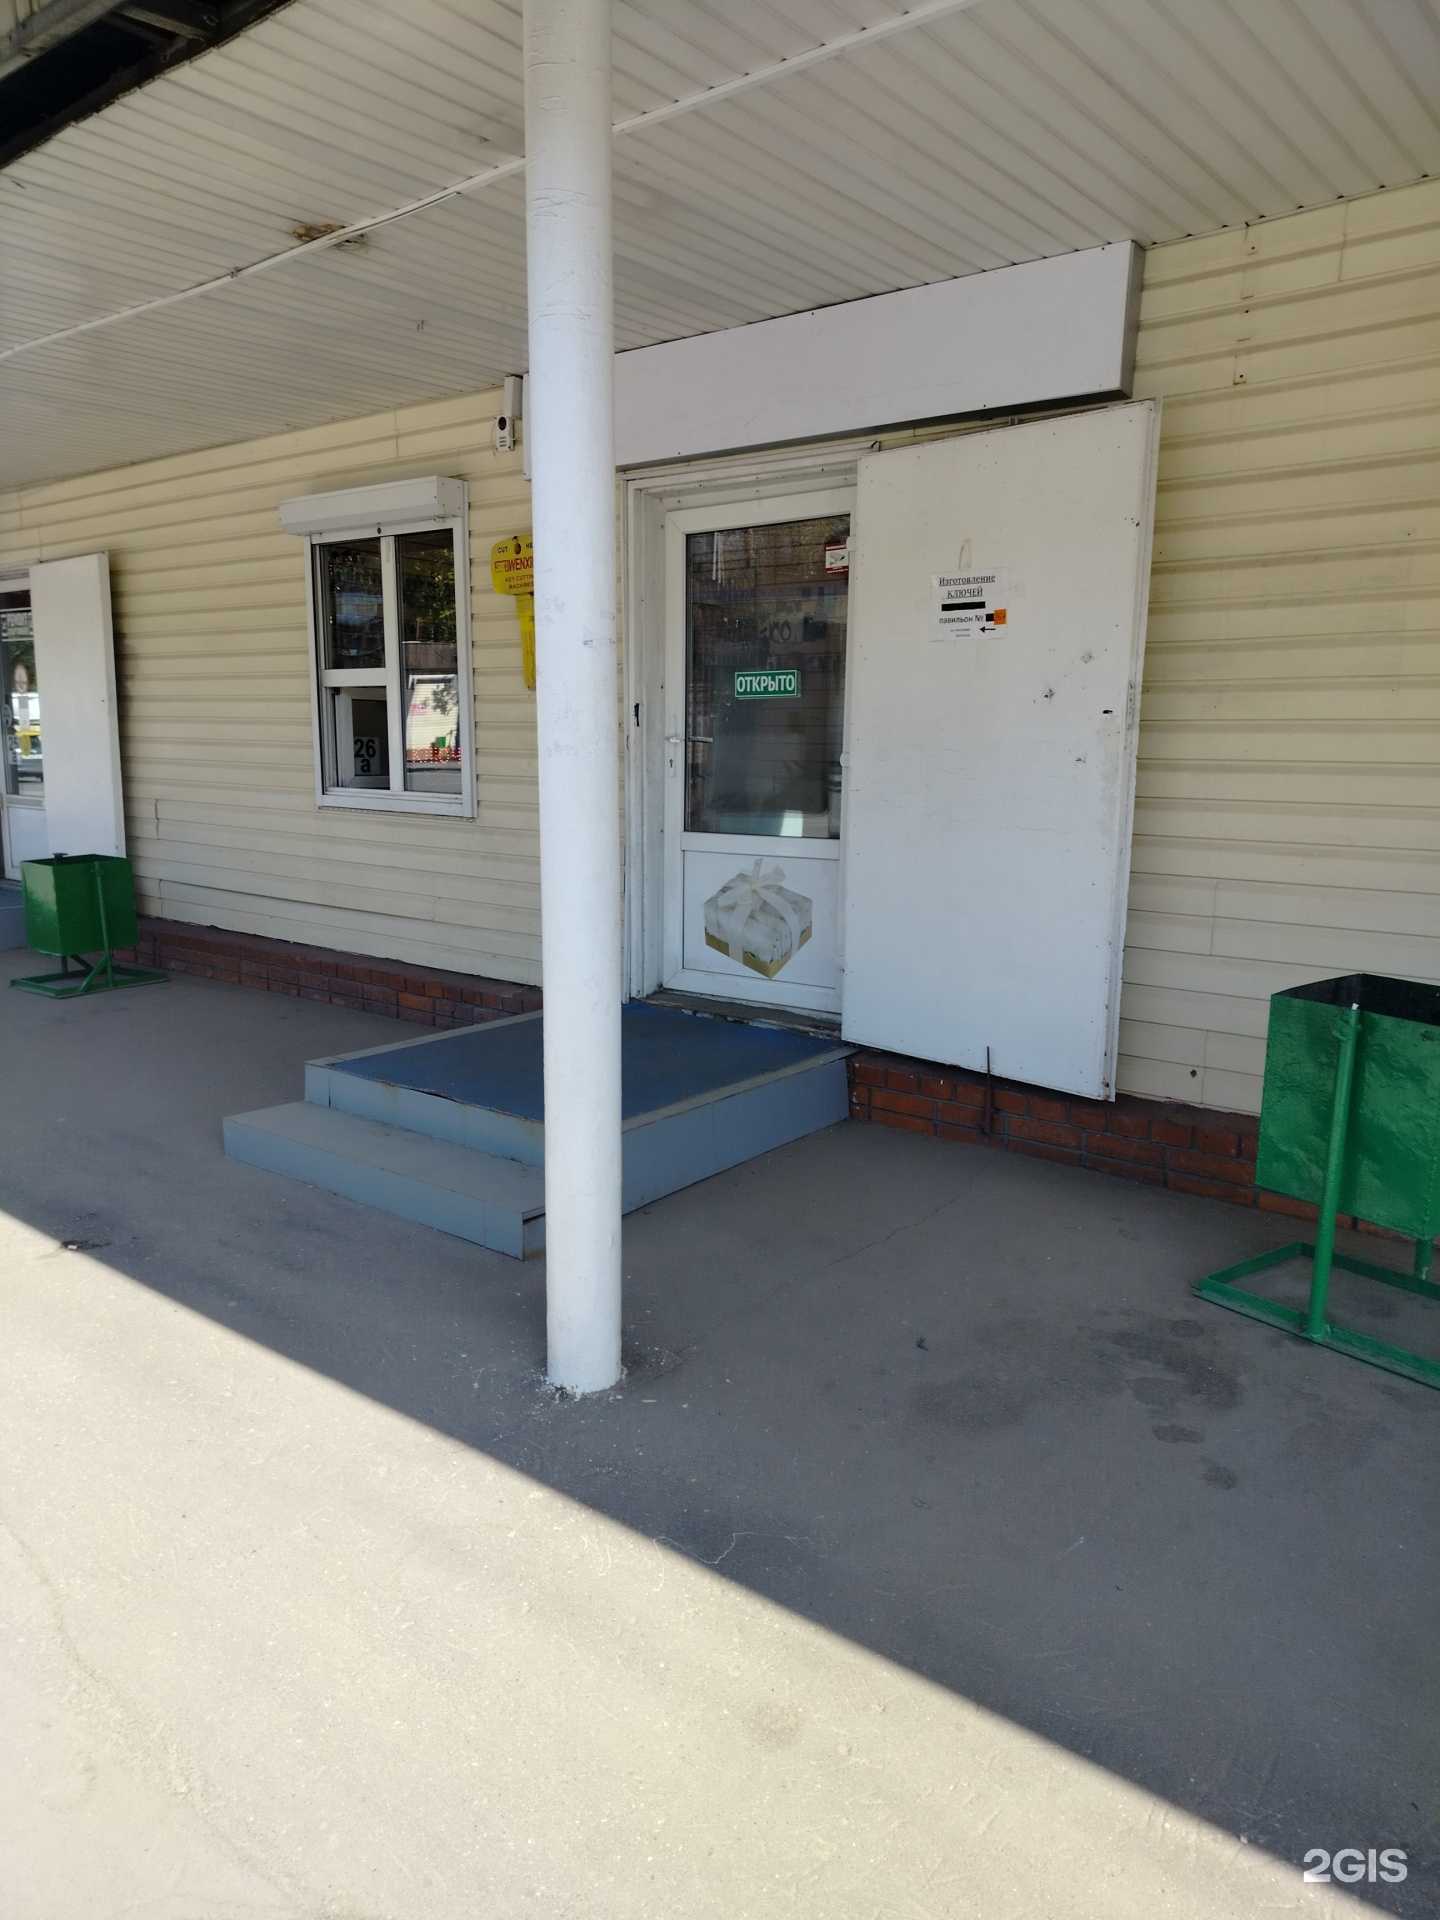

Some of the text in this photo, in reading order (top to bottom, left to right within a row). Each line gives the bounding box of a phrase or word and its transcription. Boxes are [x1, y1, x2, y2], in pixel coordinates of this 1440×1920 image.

[939, 576, 996, 586] Изготовление
[947, 586, 983, 599] КЛЮЧЕЙ
[737, 675, 795, 692] ОТКРЫТО
[354, 739, 376, 758] 26
